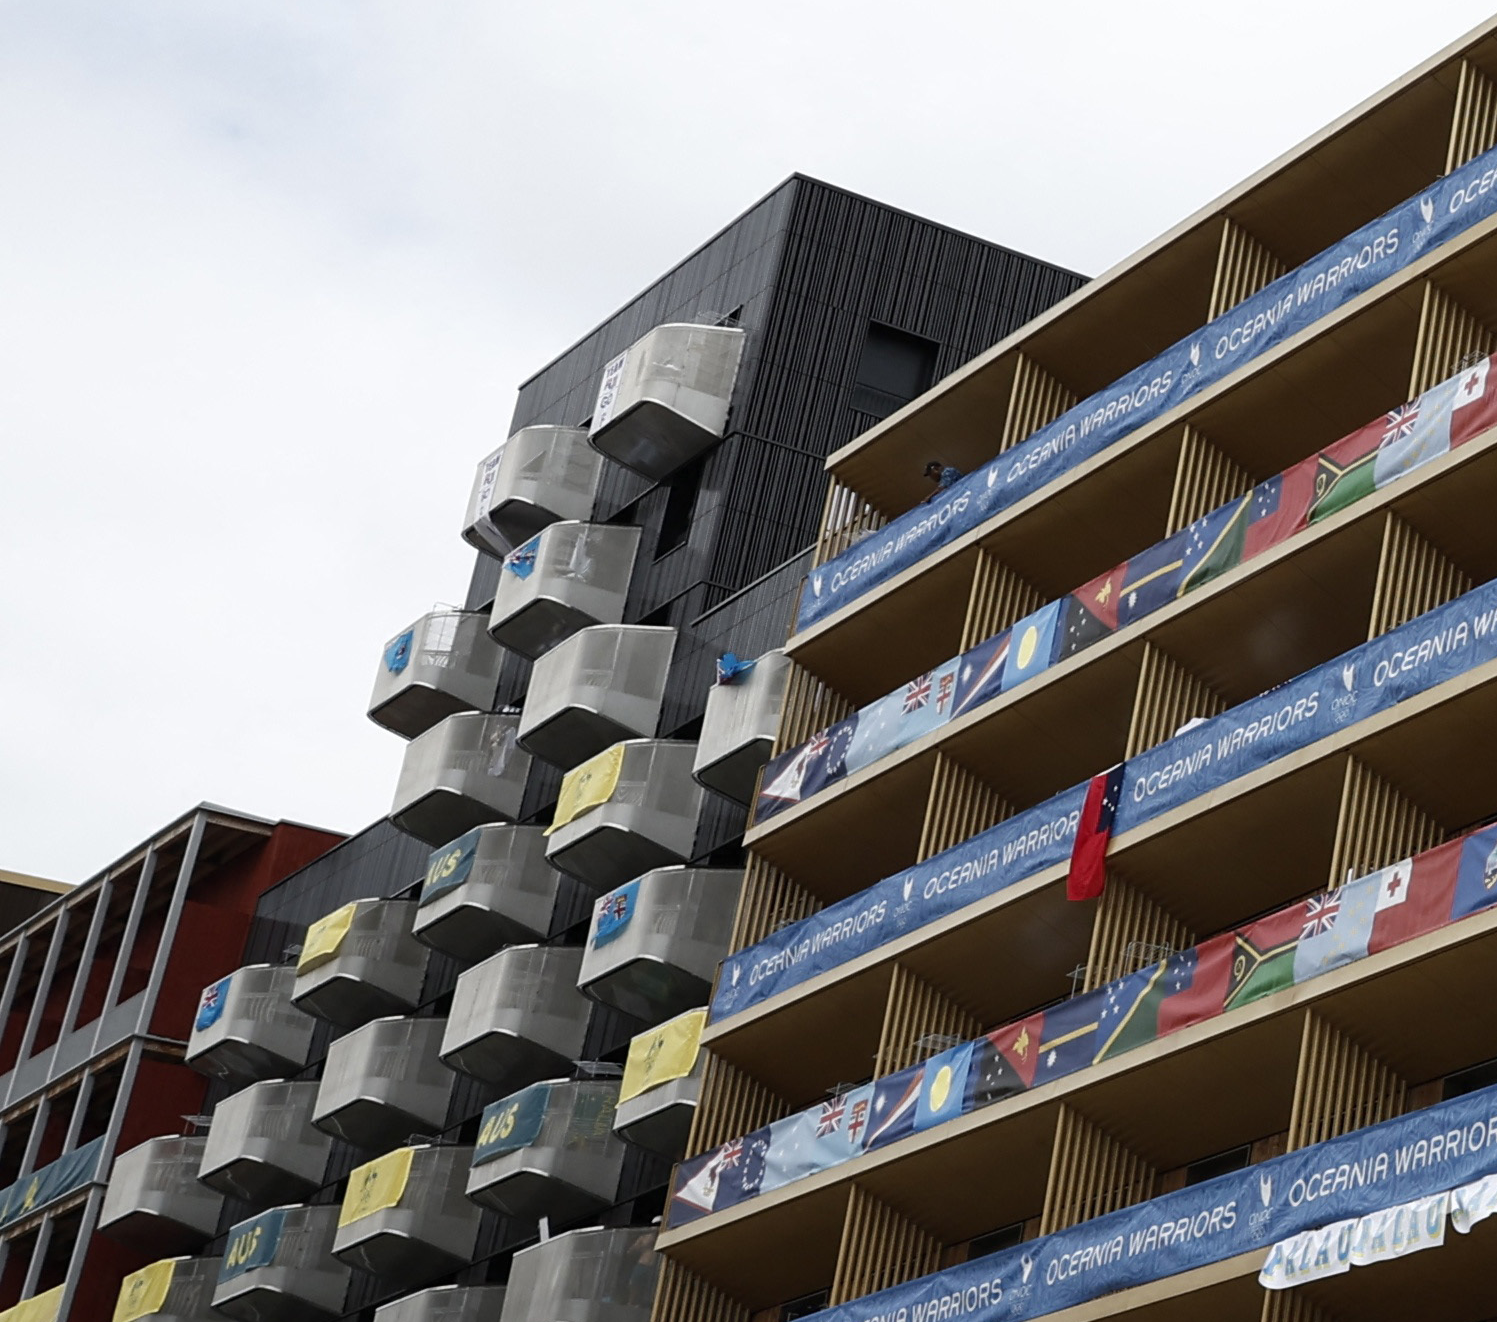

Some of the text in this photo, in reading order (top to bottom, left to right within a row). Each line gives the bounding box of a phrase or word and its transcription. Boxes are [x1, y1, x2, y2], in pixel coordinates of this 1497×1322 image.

[1214, 228, 1400, 360] OCEANIA WARRIORS
[1006, 370, 1173, 484] OCEANIA WARRIORS
[831, 540, 894, 594] OCEANIA
[1373, 621, 1469, 688] OCEANIA
[1133, 692, 1319, 803] OCEANIA WARRIORS
[923, 809, 1080, 900] OCEANIA WARRIOR
[748, 899, 888, 986] OCEANIA WARRIORS
[475, 1102, 520, 1150] AUS
[1289, 1153, 1389, 1208] OCEANIA
[226, 1226, 263, 1272] AUS
[1046, 1202, 1238, 1286] OCEANIA WARRIORS
